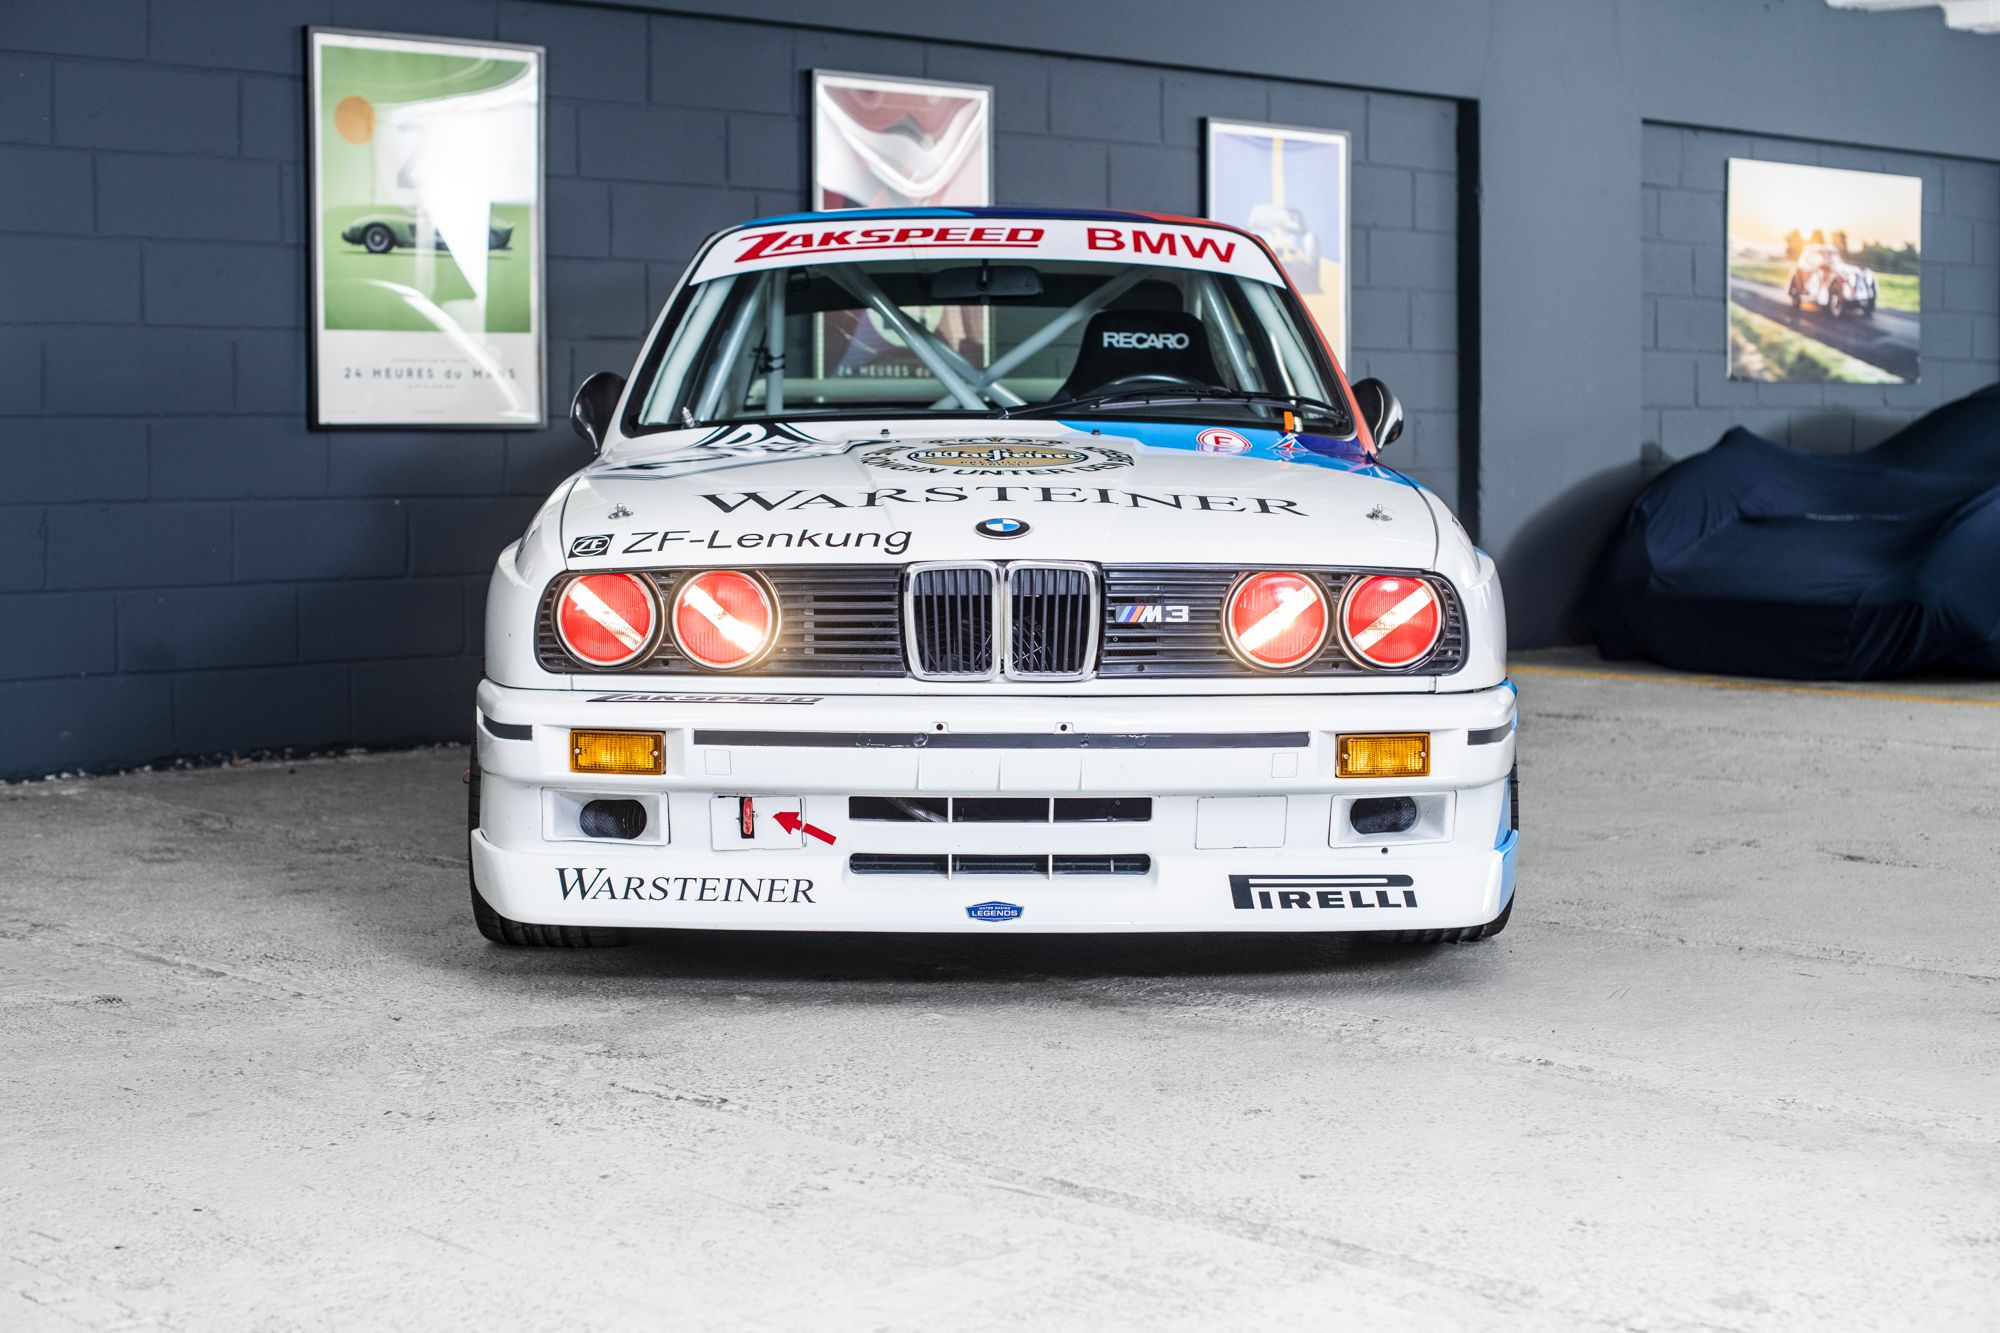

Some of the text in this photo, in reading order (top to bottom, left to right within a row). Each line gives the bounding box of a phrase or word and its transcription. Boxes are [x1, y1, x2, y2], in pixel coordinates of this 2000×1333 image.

[735, 228, 1236, 263] ZAKSPEED BMW
[1102, 331, 1190, 349] RECARO
[344, 366, 363, 379] 24
[372, 366, 435, 379] HEURES
[953, 468, 1076, 476] UNTER
[700, 485, 1309, 517] WARSTEINER
[573, 537, 610, 552] ZF
[622, 529, 913, 555] ZF-Lenkung
[585, 693, 825, 705] ZAKSPEED
[556, 867, 817, 904] WARSTEINER
[1228, 874, 1418, 910] PIRELLI
